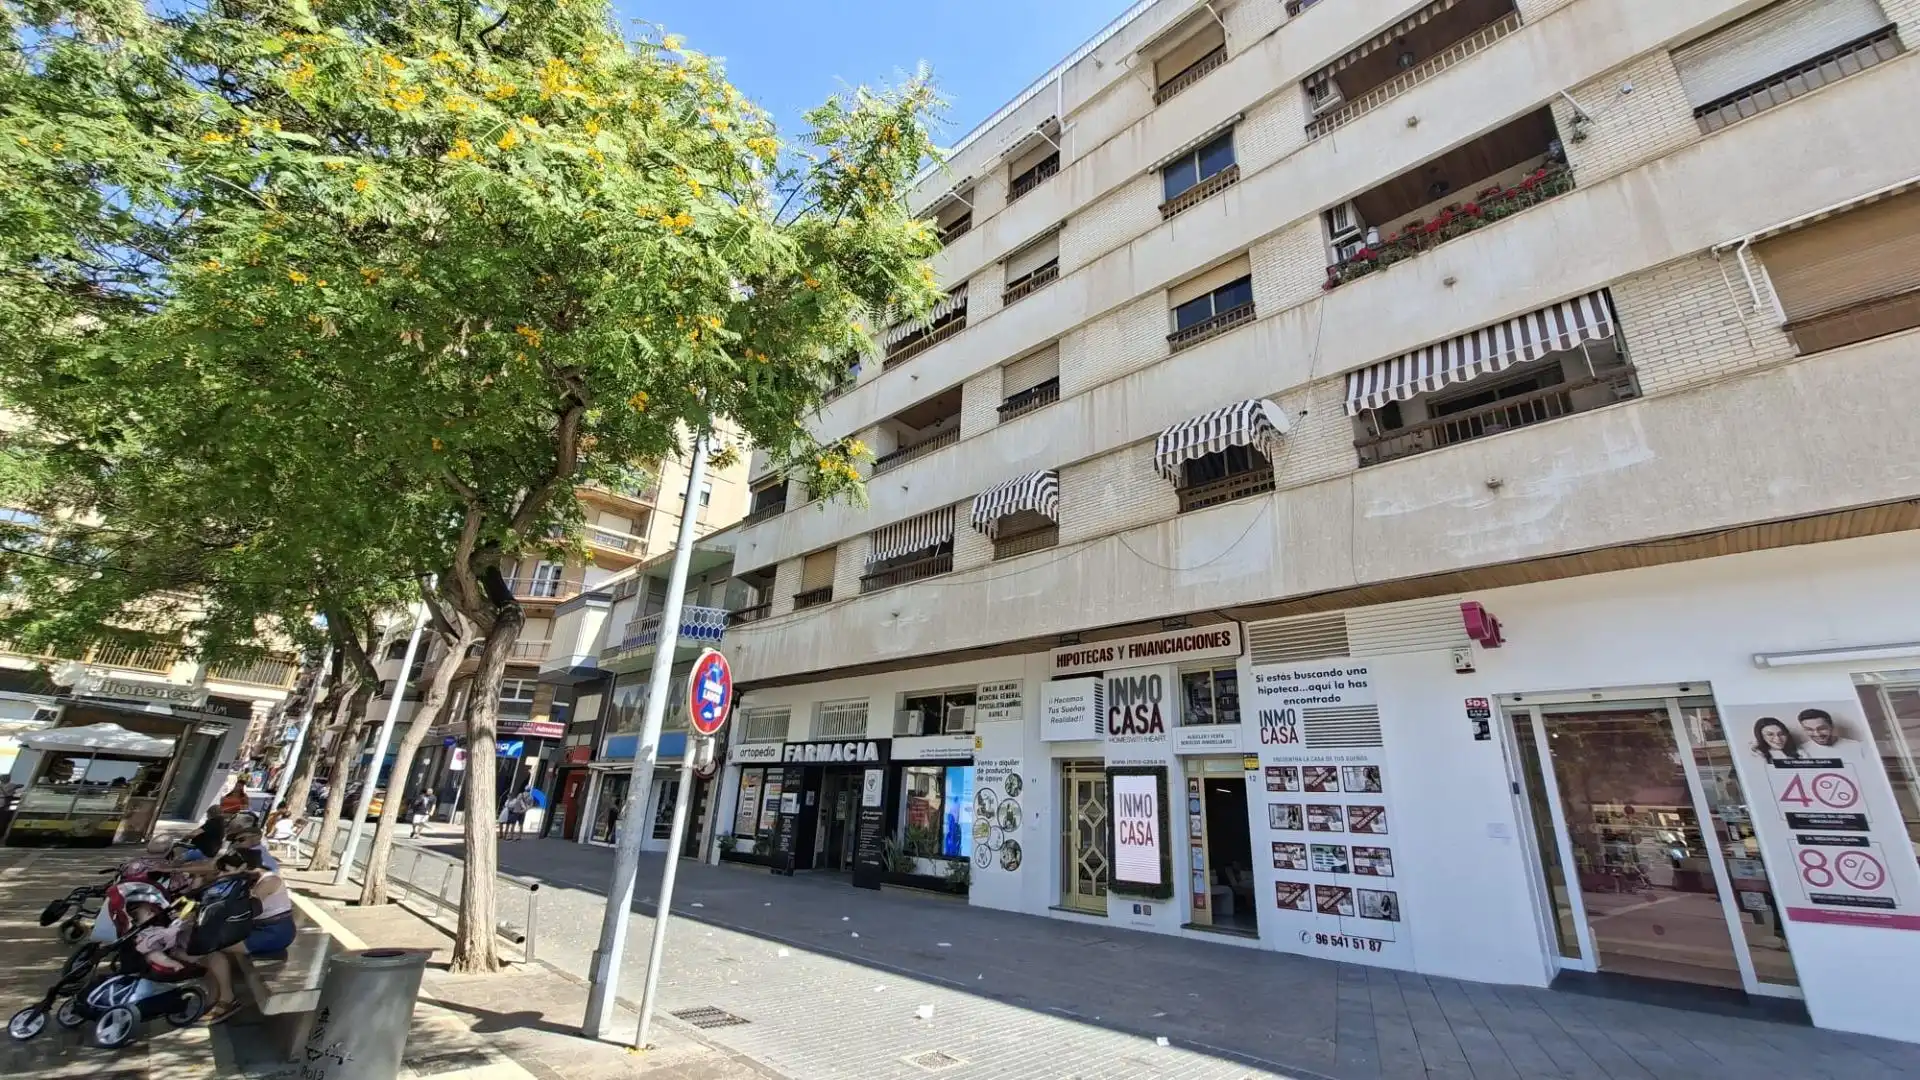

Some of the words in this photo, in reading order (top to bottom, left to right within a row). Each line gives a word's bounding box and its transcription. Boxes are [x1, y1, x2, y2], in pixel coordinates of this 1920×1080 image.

[1056, 647, 1114, 668] HIPOTECAS
[1117, 645, 1125, 660] Y
[1128, 630, 1231, 659] FINANCIACIONES
[1255, 674, 1264, 683] Si
[1294, 668, 1343, 680] buscando
[1346, 667, 1368, 676] una
[1334, 681, 1345, 689] la
[1348, 680, 1368, 689] has
[1000, 691, 1022, 700] GENERAL
[1108, 674, 1163, 706] INMO
[1283, 694, 1341, 706] encontrado
[1048, 706, 1059, 714] Tus
[1108, 703, 1165, 735] CASA
[1259, 707, 1297, 728] INMO
[1260, 726, 1300, 745] CASA
[739, 745, 776, 758] ortopedia
[783, 742, 880, 762] FARMACIA
[998, 759, 1020, 767] alquiler
[1119, 793, 1153, 818] INMO
[1119, 820, 1154, 847] CASA
[1315, 933, 1328, 945] 96
[1330, 936, 1349, 948] 541
[1353, 938, 1365, 950] 51
[1368, 940, 1382, 952] 87
